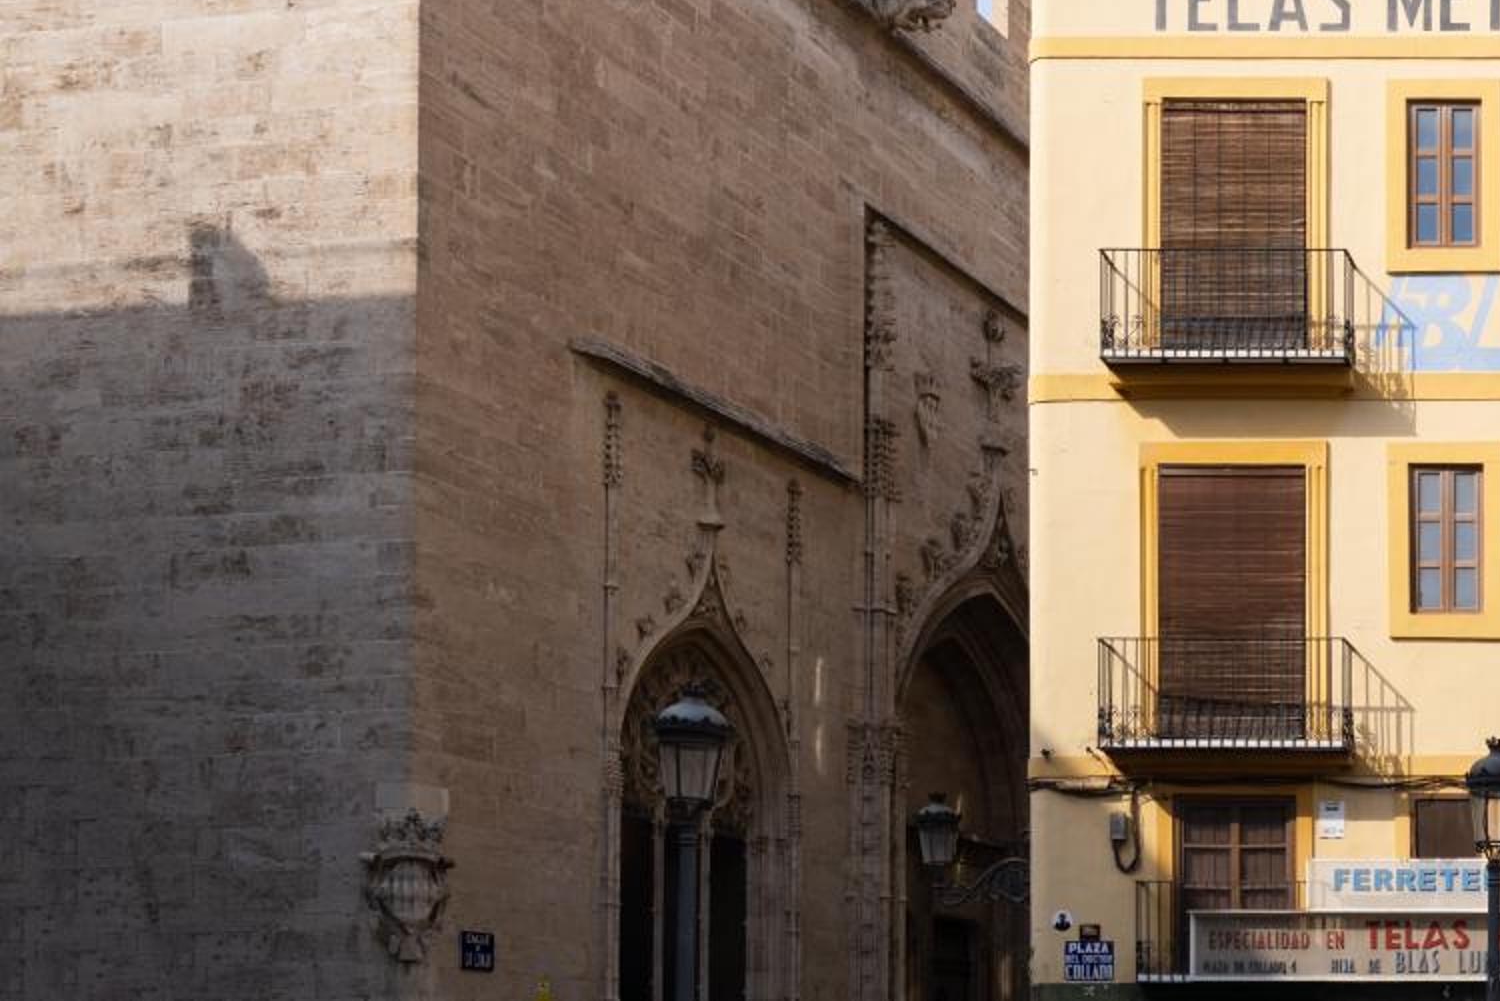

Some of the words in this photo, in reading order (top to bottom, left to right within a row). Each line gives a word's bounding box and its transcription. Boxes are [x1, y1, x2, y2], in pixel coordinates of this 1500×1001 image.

[1208, 930, 1310, 950] ESPECIALIDAD
[1326, 930, 1345, 950] EN
[1366, 919, 1471, 950] TELAS
[1068, 942, 1110, 954] PLAZA
[1395, 951, 1440, 974] BLAS
[1065, 965, 1113, 980] COLLADO
